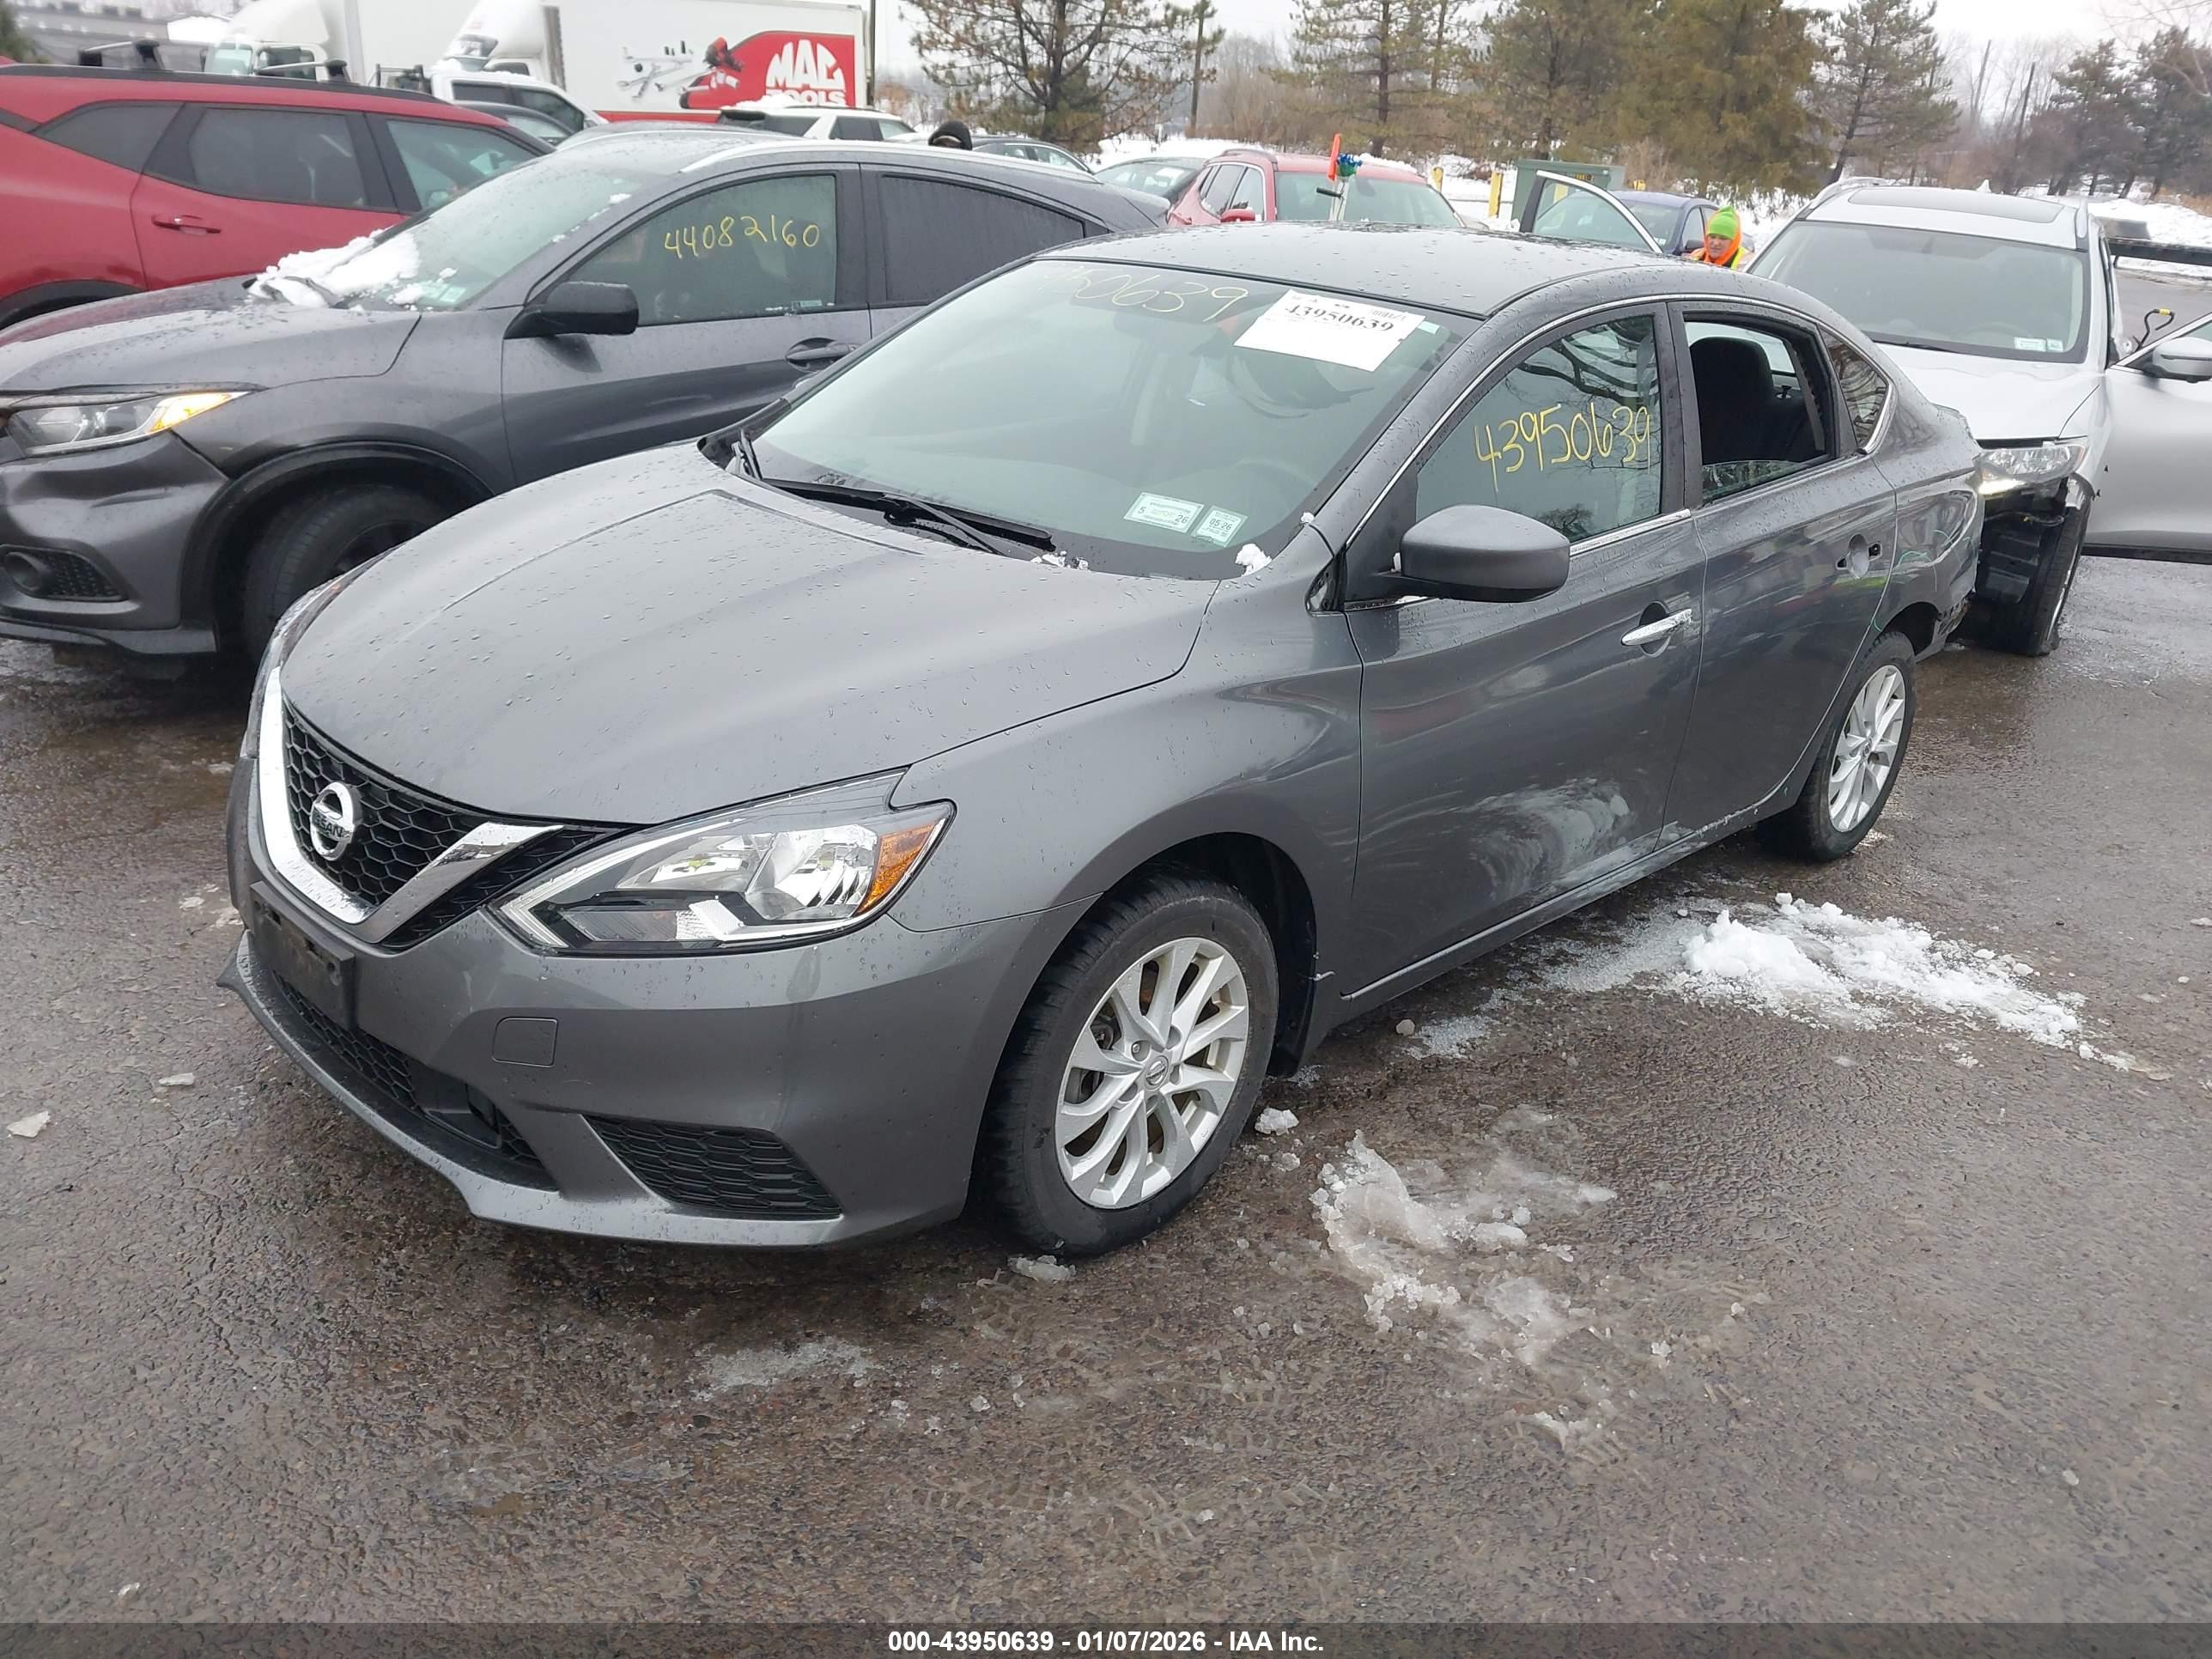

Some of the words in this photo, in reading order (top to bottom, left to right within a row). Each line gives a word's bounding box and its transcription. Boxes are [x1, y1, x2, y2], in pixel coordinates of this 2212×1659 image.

[765, 39, 846, 88] MAC
[665, 215, 819, 258] 44082160
[1285, 303, 1395, 331] 43950639
[1474, 402, 1652, 492] 43950639
[1175, 514, 1188, 524] 26
